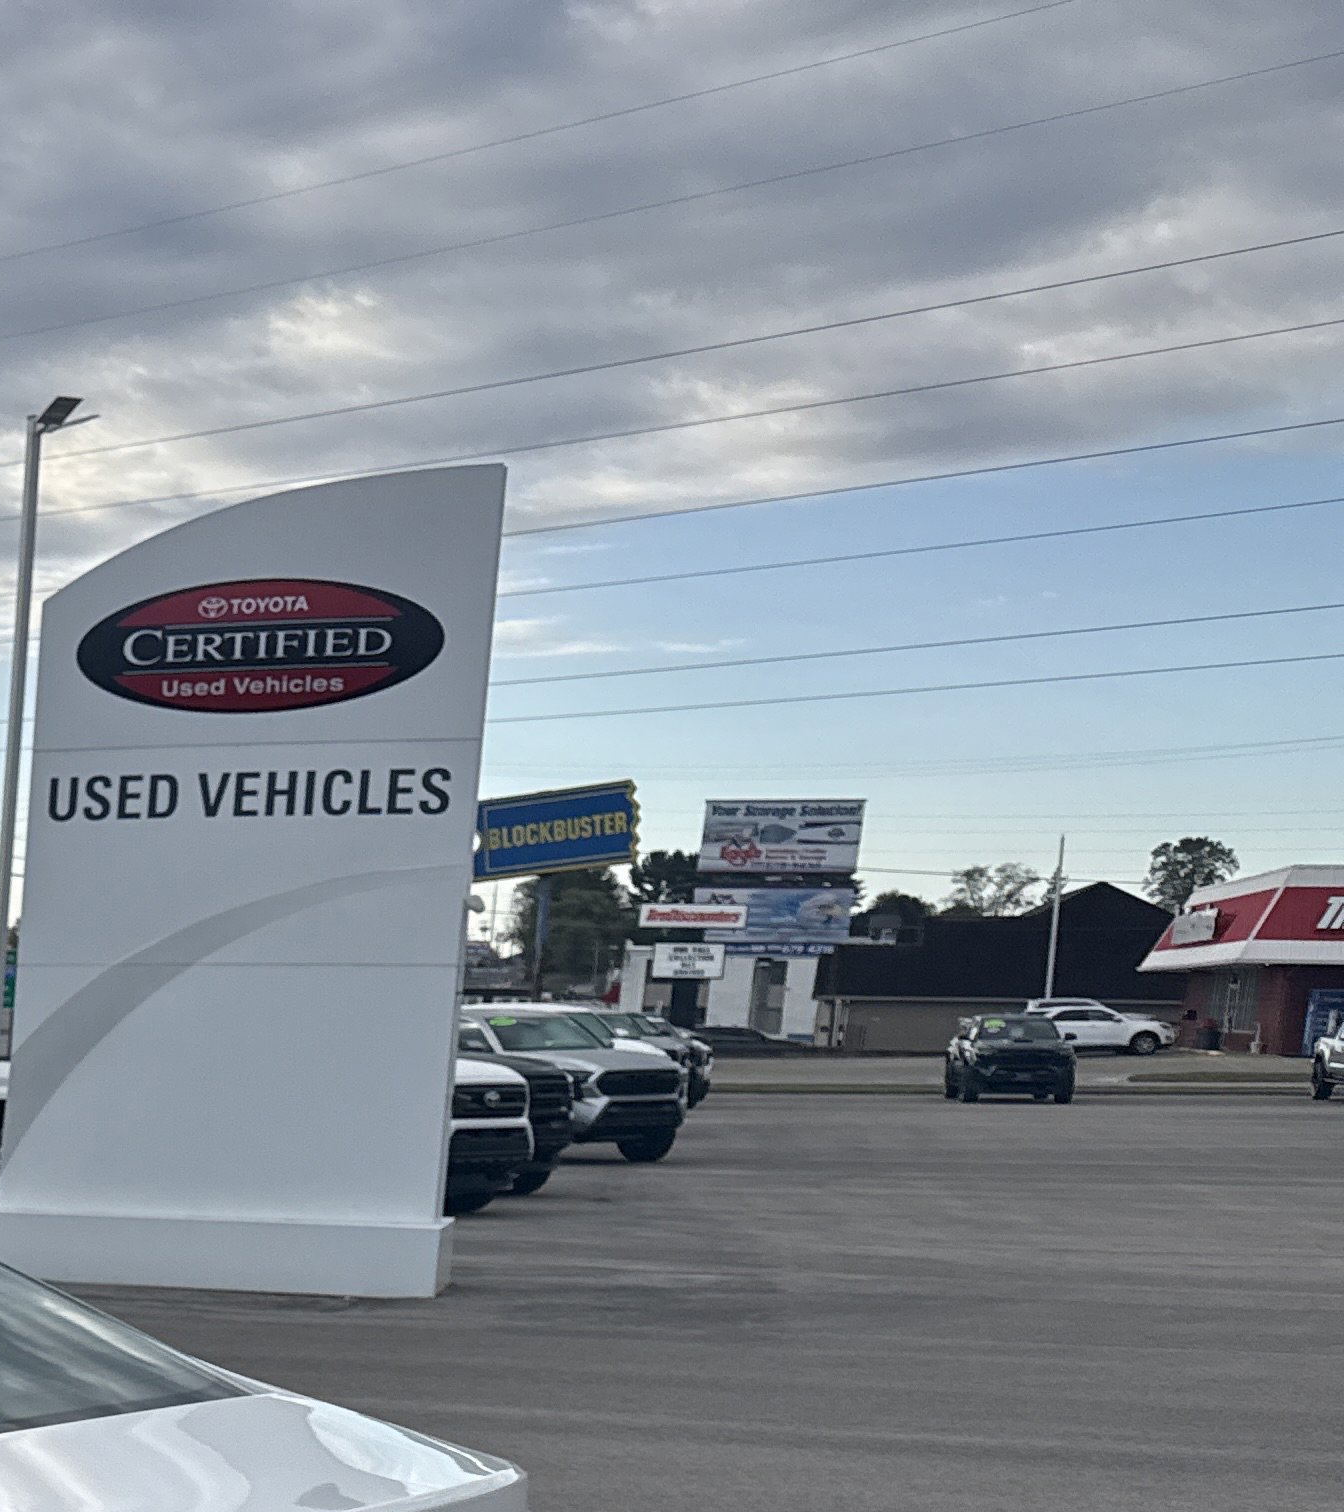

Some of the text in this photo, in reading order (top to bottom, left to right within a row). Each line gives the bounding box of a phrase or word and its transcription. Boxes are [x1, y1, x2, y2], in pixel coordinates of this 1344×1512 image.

[229, 596, 309, 615] TOYOTA
[122, 627, 393, 666] CERTIFIED
[161, 674, 345, 697] Used Vehicles
[47, 767, 452, 822] USED VEHICLES
[487, 811, 628, 850] BLOCKBUSTER
